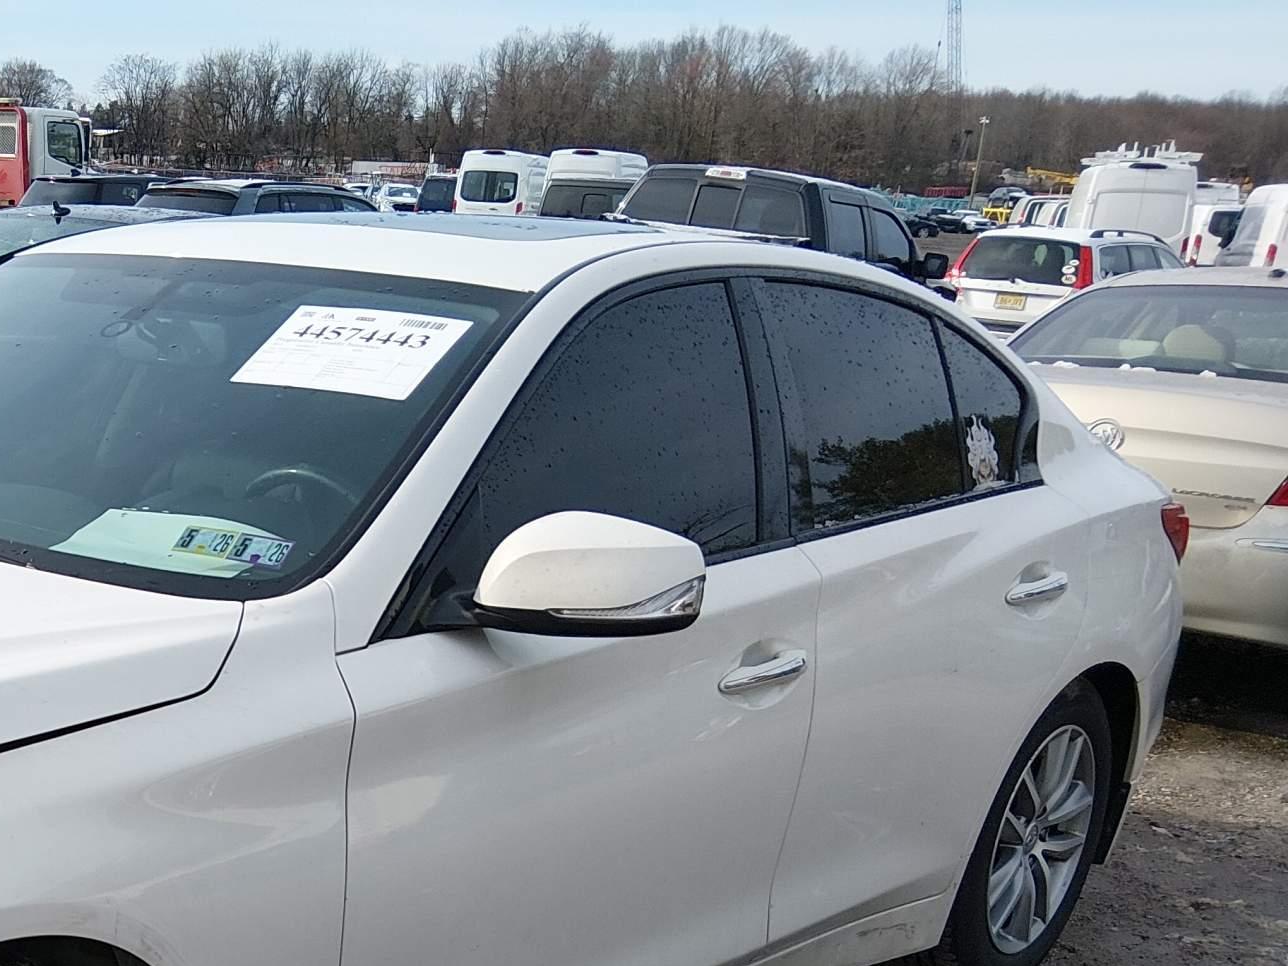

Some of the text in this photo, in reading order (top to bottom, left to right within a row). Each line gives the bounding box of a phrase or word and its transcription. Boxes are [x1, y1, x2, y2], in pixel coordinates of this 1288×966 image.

[292, 323, 432, 350] 44574443
[180, 528, 235, 553] 5 26
[234, 537, 290, 564] 5 26
